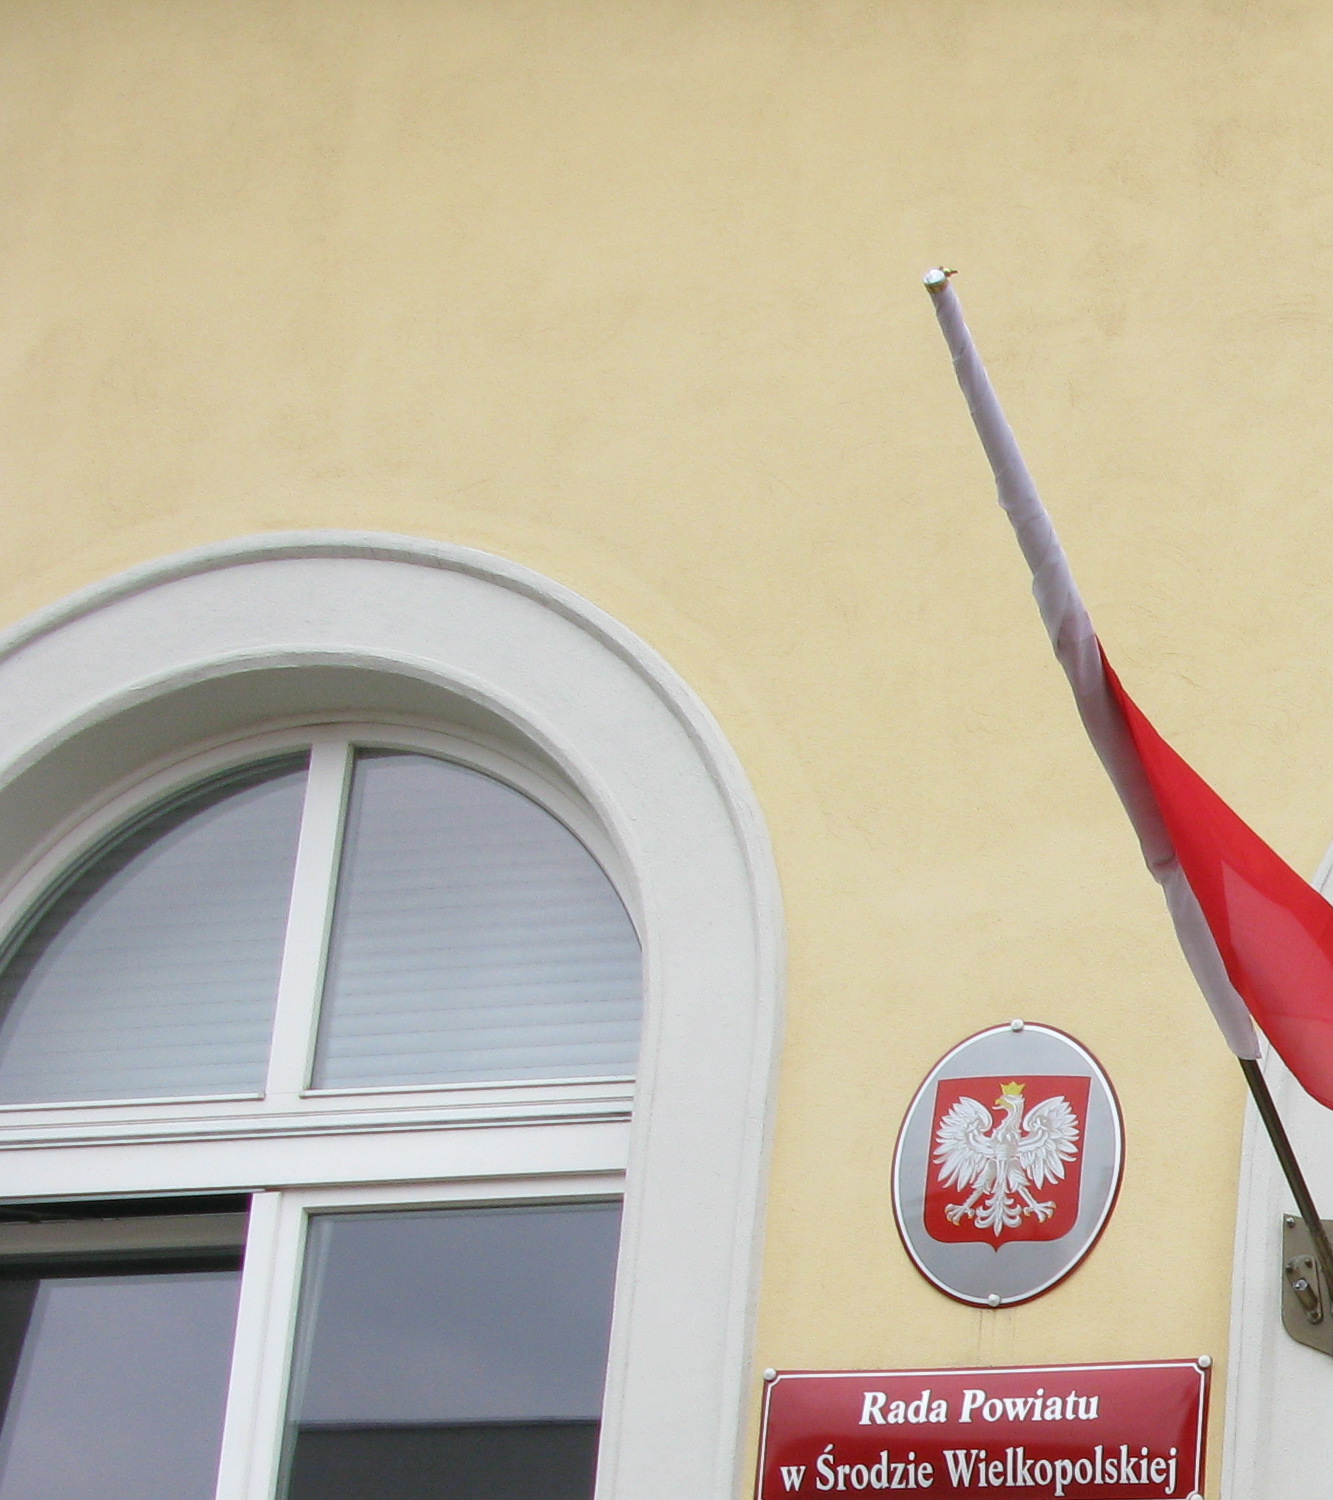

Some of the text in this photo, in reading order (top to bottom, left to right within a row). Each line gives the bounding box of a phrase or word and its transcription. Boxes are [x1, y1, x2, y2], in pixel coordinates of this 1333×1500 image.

[858, 1387, 1099, 1425] Rada Powiatu
[779, 1443, 1177, 1497] w Środzie Wielkopolskiej
